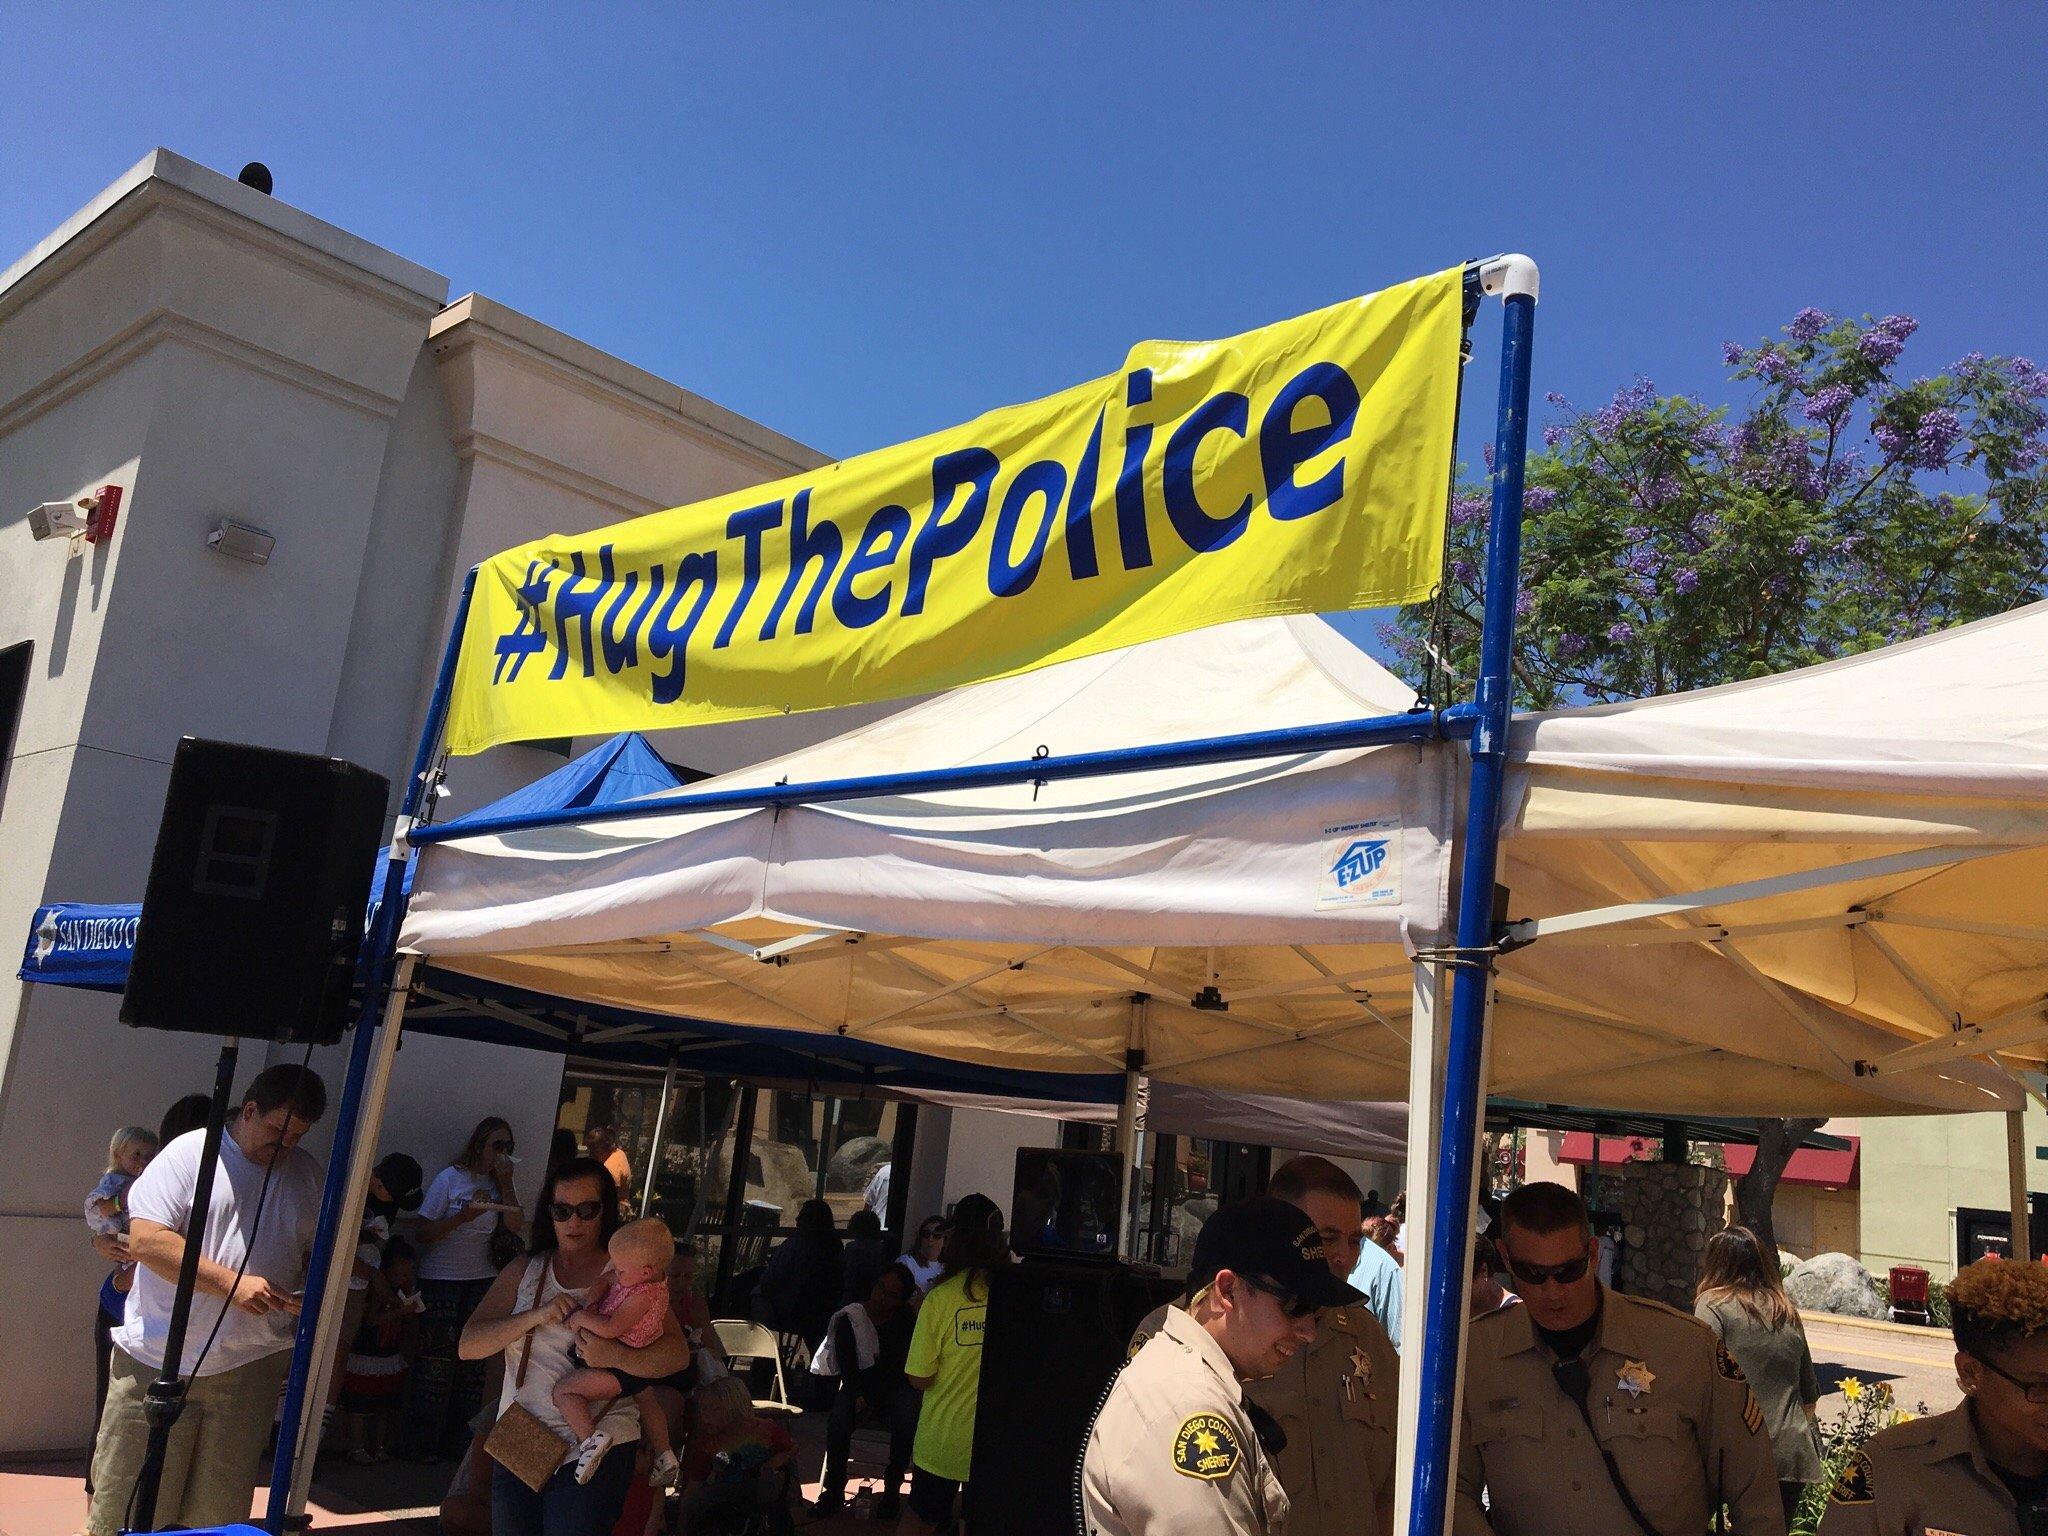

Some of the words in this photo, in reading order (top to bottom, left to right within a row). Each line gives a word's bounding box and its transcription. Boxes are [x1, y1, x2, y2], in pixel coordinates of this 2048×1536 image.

[492, 361, 1362, 704] #HugThePolice
[58, 919, 84, 952] SAN
[82, 917, 126, 950] DIEGO
[1181, 1418, 1206, 1440] DIEGO
[1208, 1418, 1238, 1449] COUNTY
[1176, 1440, 1188, 1463] SAN
[1196, 1454, 1230, 1472] SHERIFF
